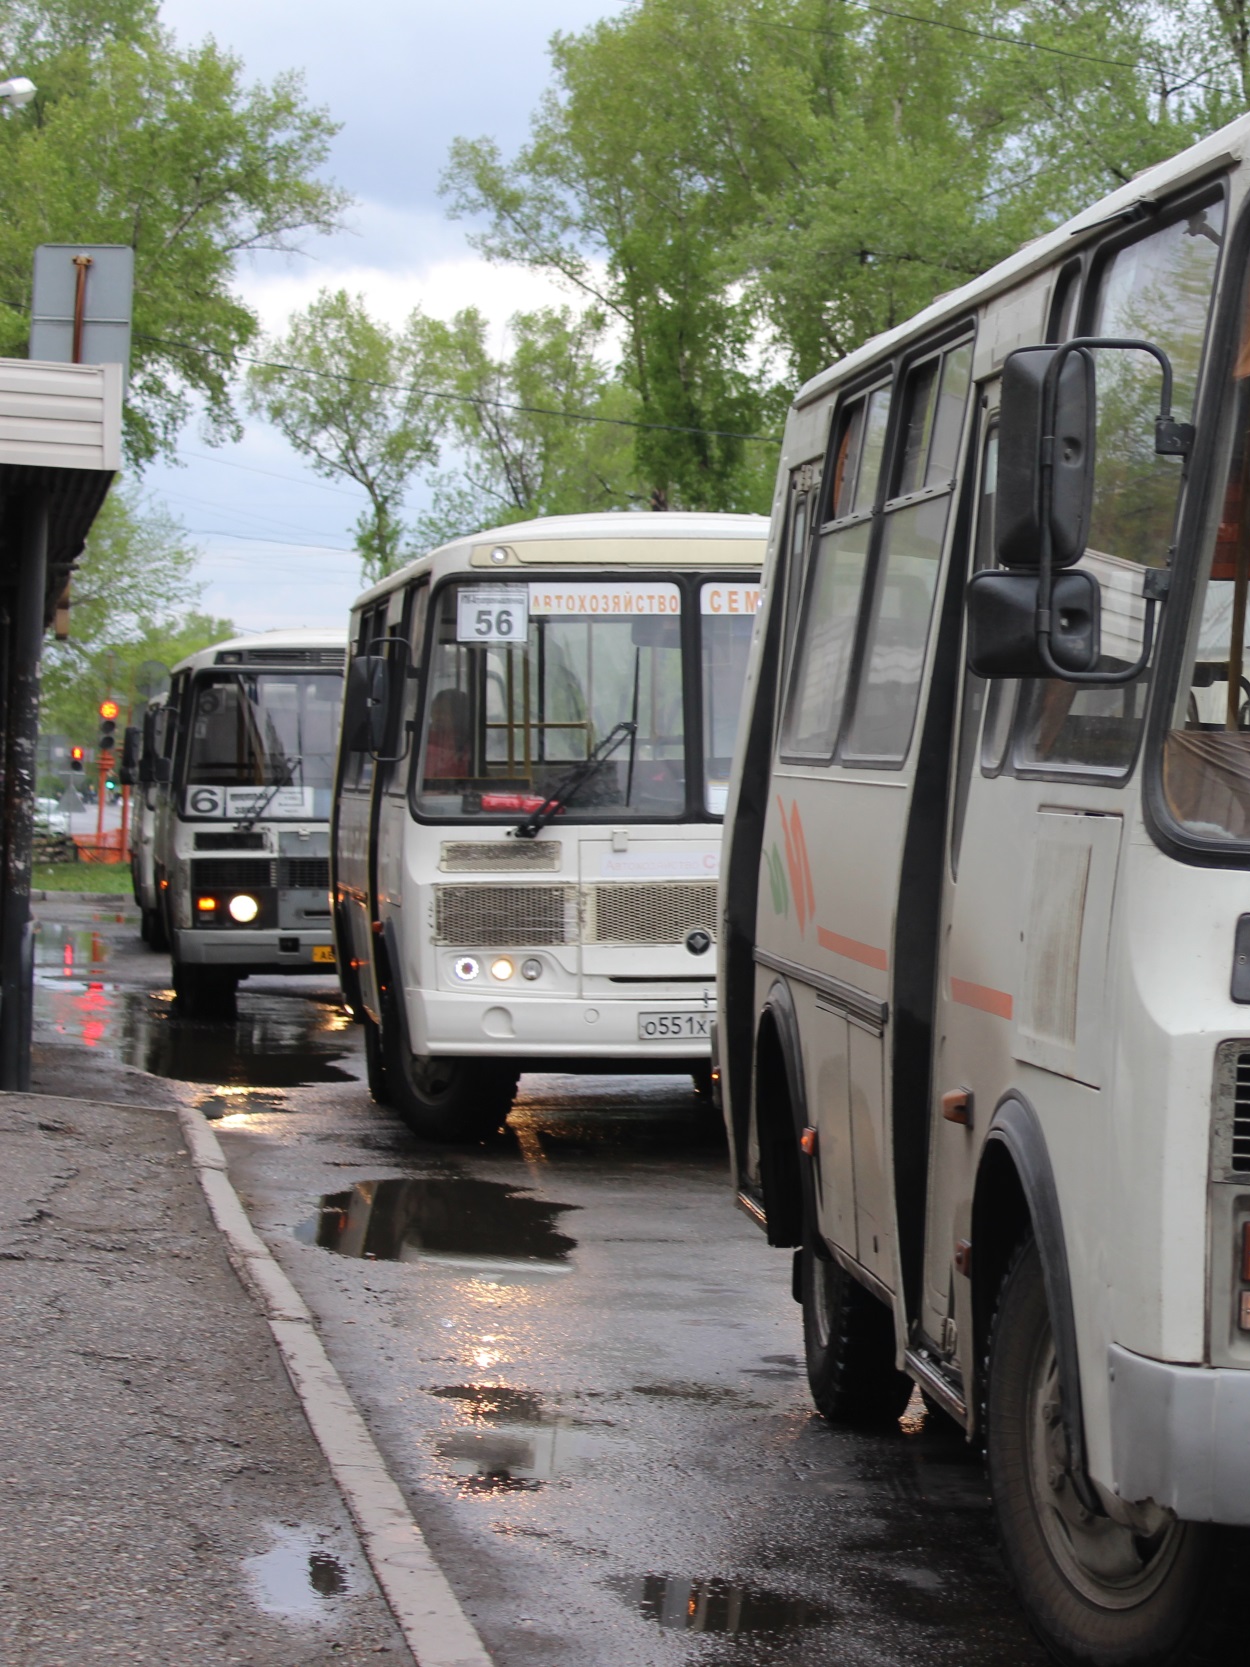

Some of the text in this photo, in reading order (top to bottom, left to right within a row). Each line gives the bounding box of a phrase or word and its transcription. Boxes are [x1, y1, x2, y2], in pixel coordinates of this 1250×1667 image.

[533, 592, 679, 613] АВТОХОЗЯЙСТВО
[474, 610, 513, 636] 56
[190, 788, 219, 814] 6
[644, 1016, 716, 1036] О551Х
